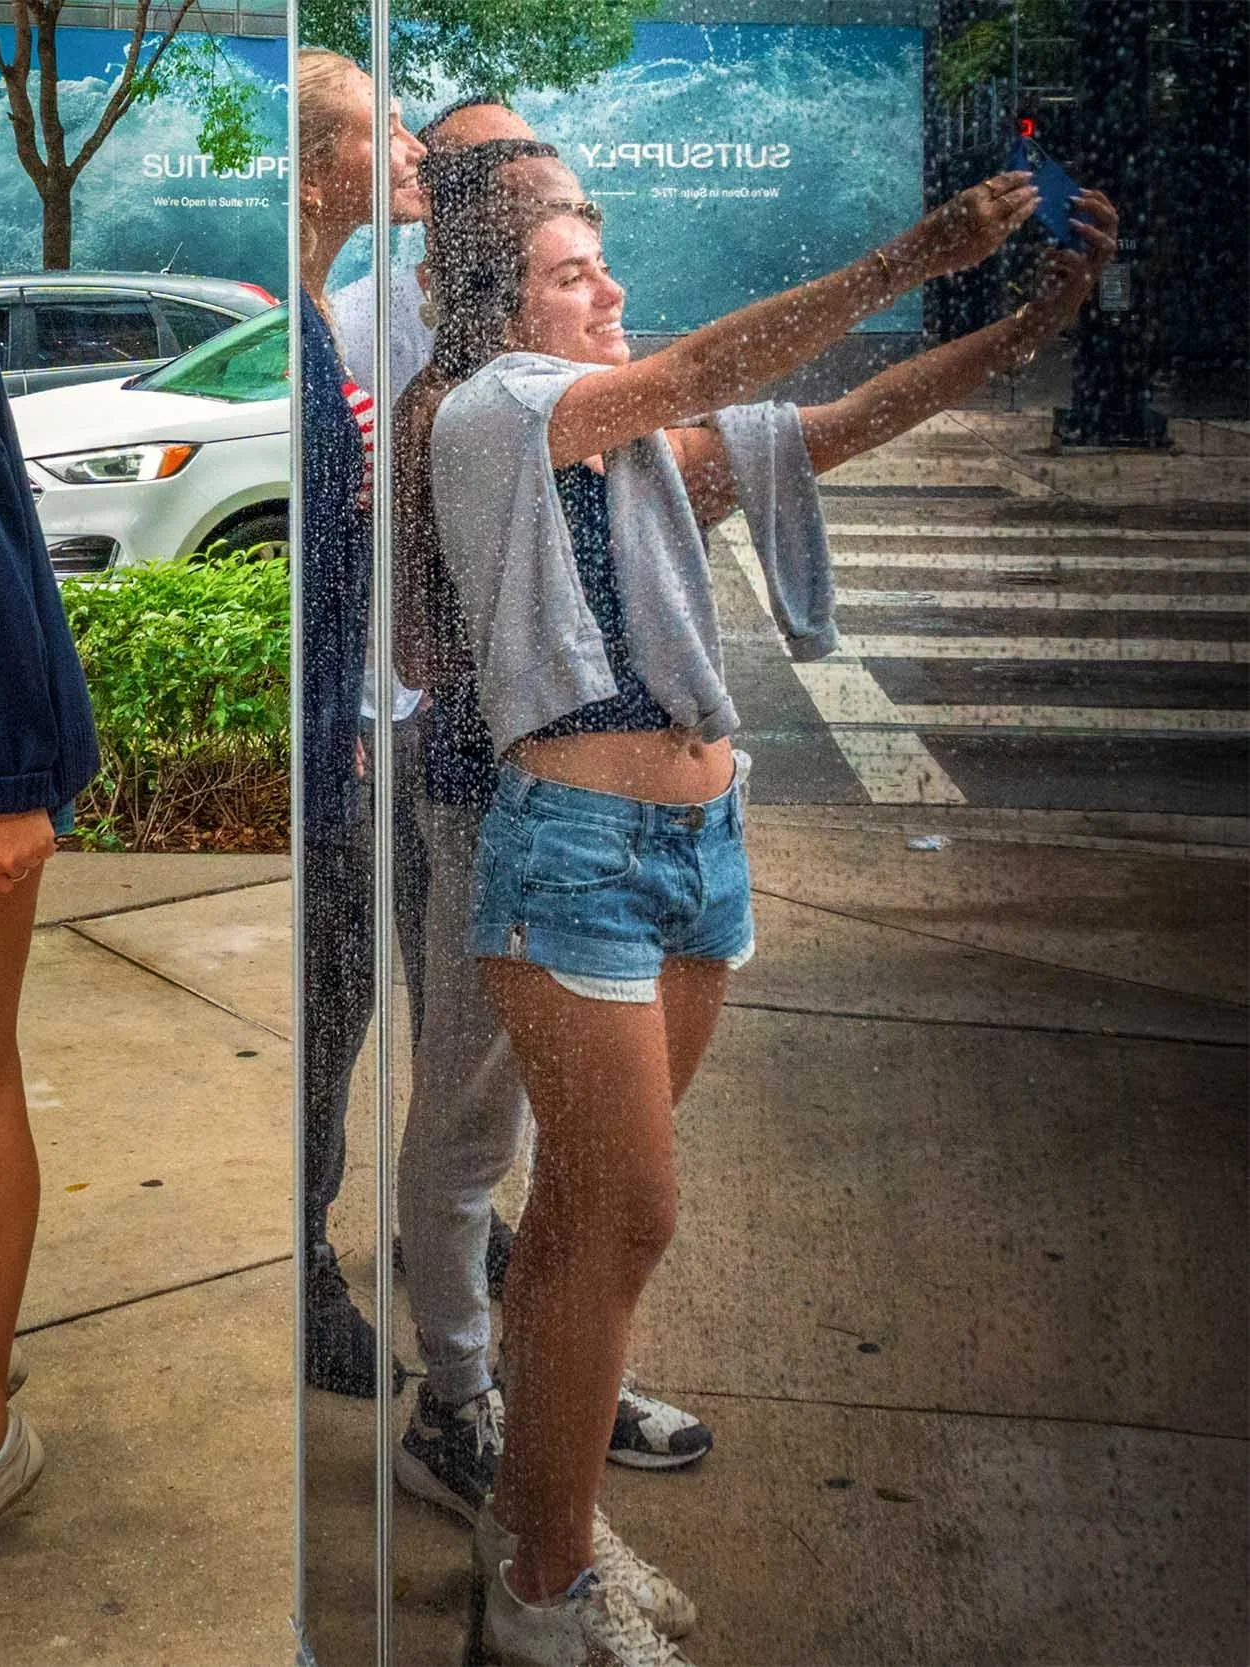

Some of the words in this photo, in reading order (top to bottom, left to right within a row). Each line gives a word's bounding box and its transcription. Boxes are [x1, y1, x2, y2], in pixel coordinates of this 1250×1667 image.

[153, 196, 179, 207] We're
[181, 196, 206, 208] Open
[208, 197, 217, 207] in
[218, 197, 243, 208] Suite
[245, 198, 269, 208] 177-C
